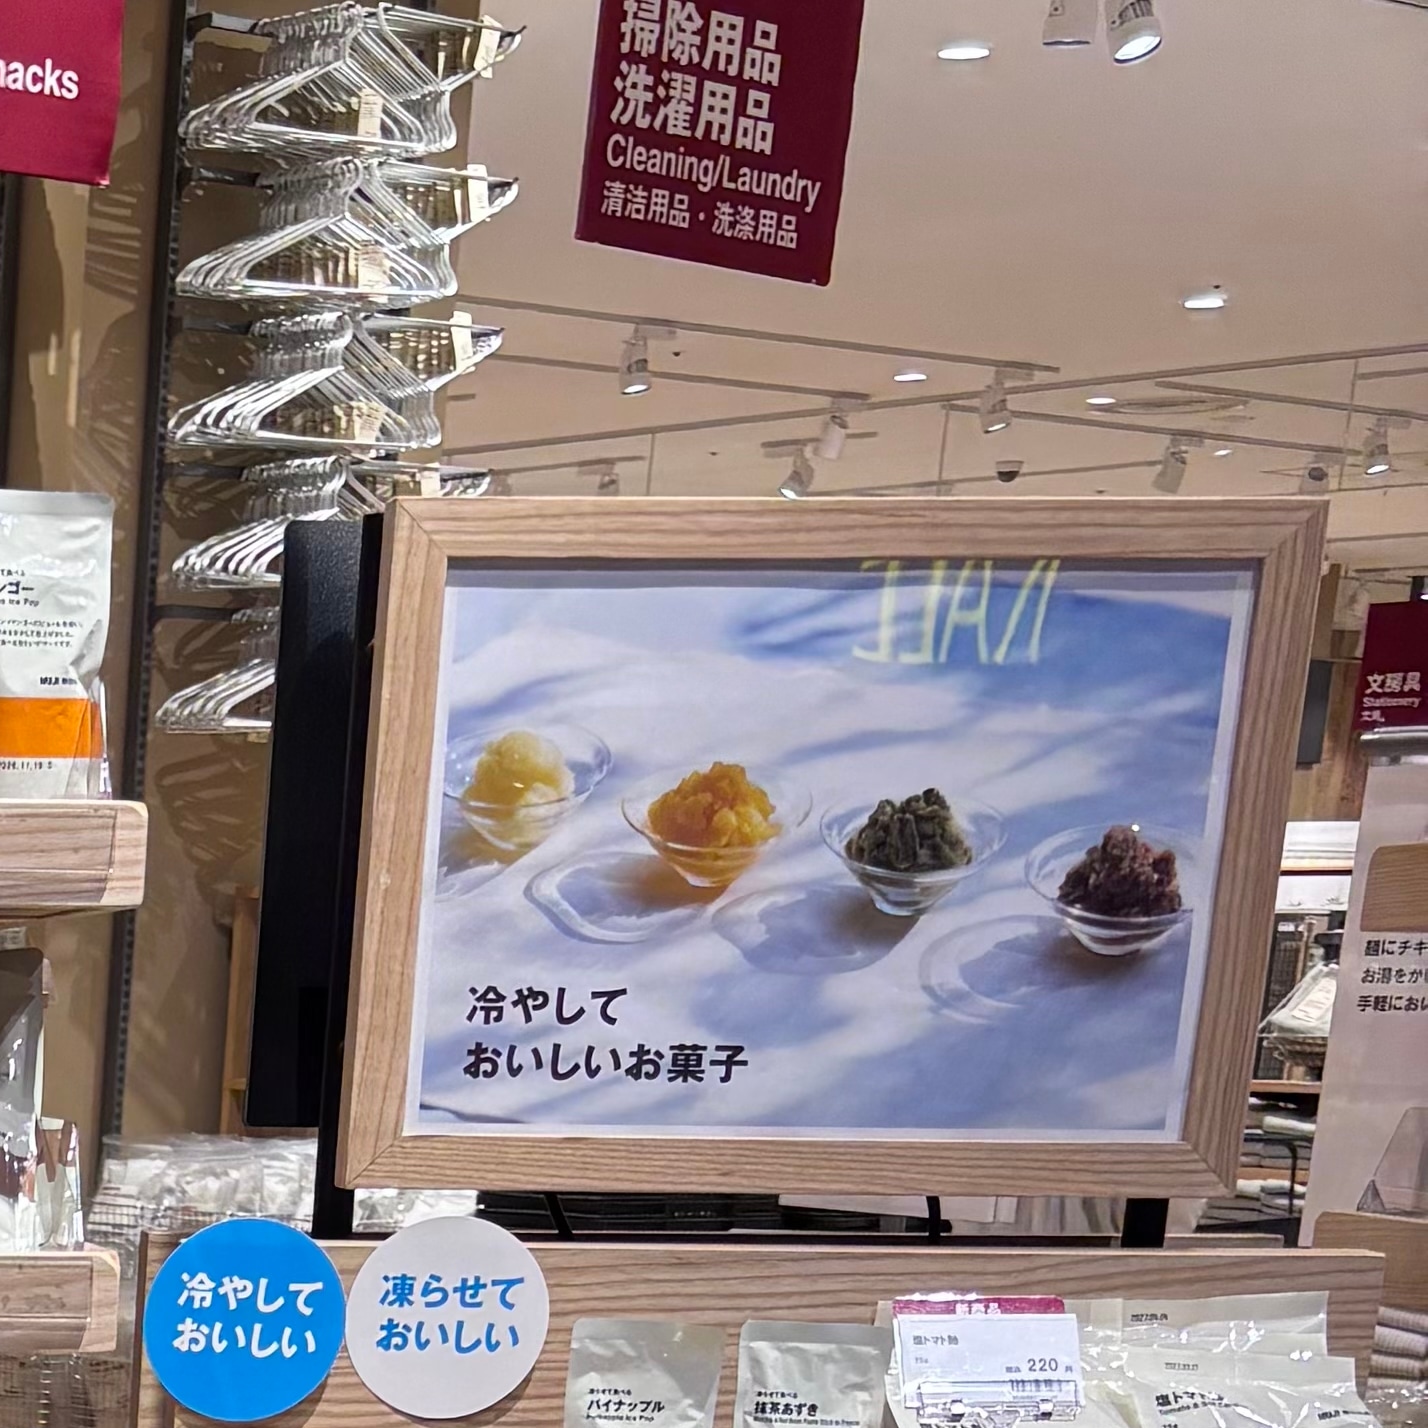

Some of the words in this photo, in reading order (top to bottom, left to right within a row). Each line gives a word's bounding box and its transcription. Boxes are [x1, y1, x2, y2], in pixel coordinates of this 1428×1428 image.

[619, 0, 782, 87] 掃除用品
[610, 60, 775, 155] 洗濯用品
[606, 133, 821, 212] Cleaning/Laundry
[465, 985, 627, 1026] 冷やして
[463, 1042, 748, 1083] おいしいお菓子
[176, 1272, 323, 1316] 冷やして
[379, 1274, 526, 1311] 凍らせて
[172, 1318, 316, 1359] おいしい
[376, 1319, 520, 1354] おいしい
[1027, 1357, 1058, 1373] 220
[587, 1399, 664, 1414] パイナップル
[754, 1401, 819, 1417] 抹茶あずき
